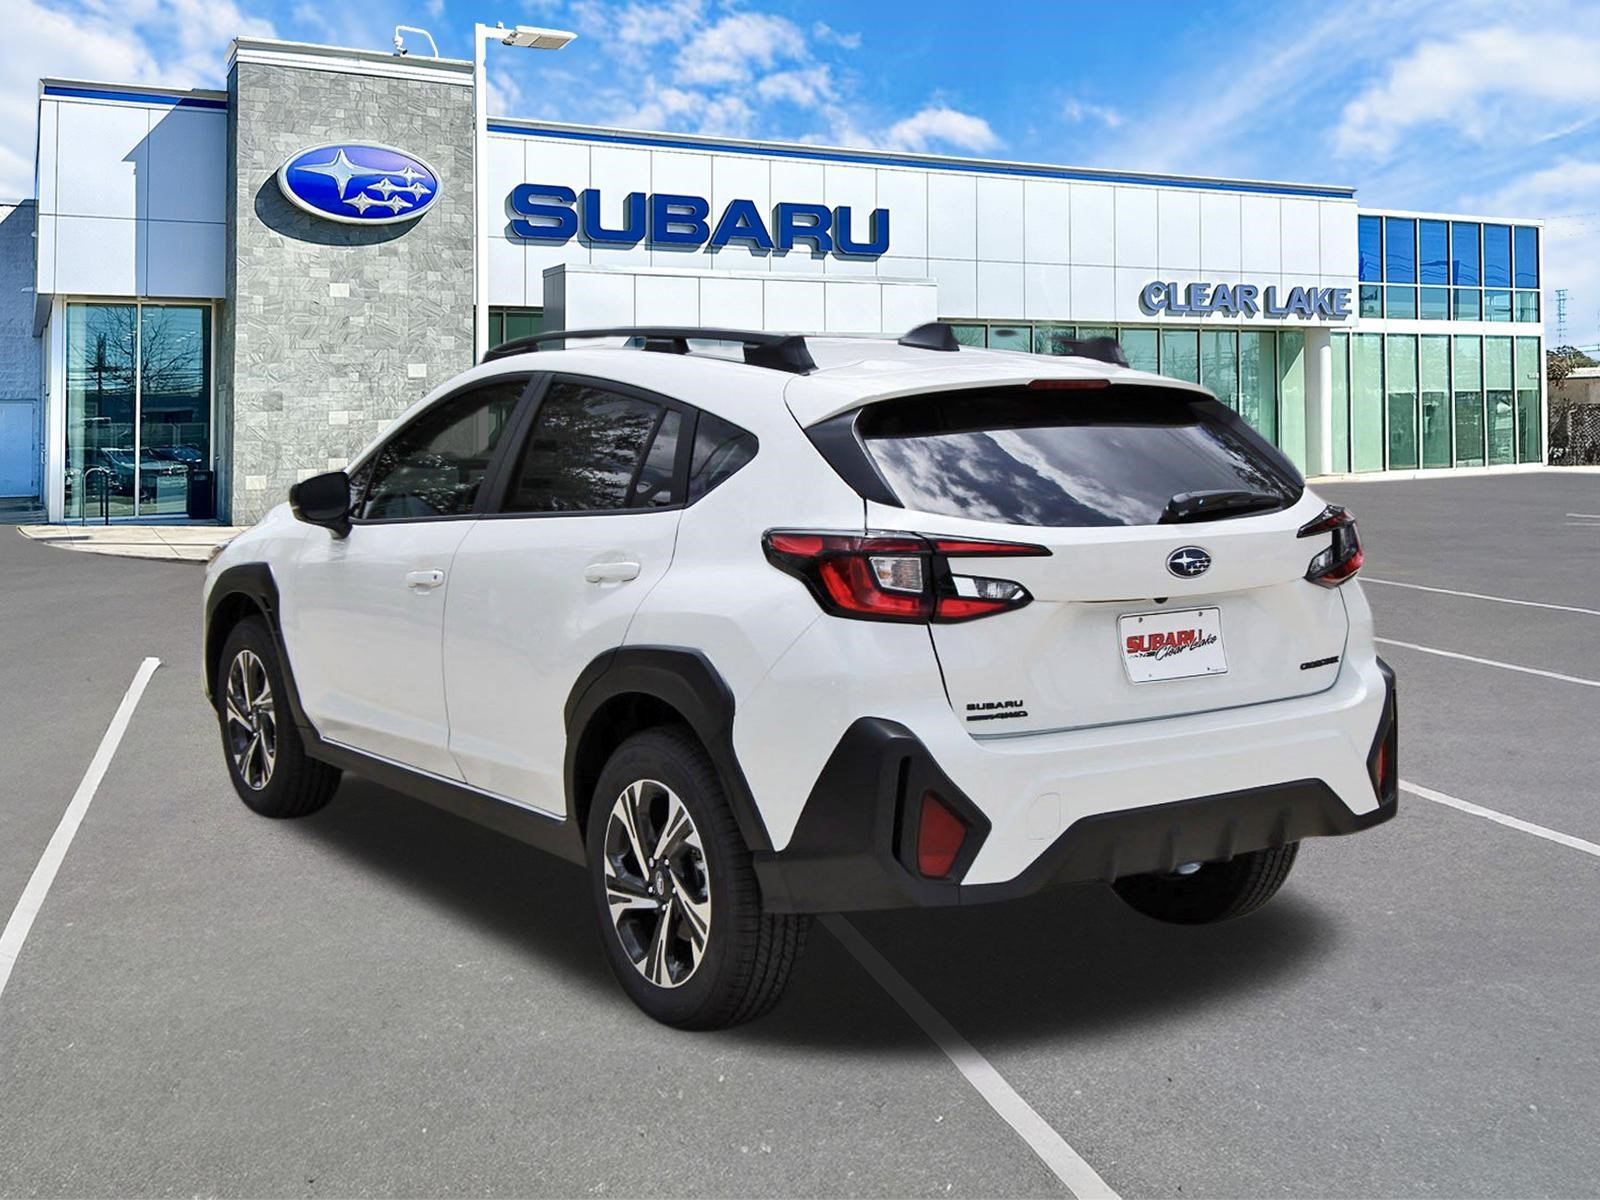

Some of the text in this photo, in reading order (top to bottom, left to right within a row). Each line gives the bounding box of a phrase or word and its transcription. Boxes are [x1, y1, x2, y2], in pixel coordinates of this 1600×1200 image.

[505, 182, 890, 261] SUBARU
[1140, 281, 1352, 319] CLEAR LAKE
[1127, 628, 1202, 653] SUBARU
[1155, 644, 1191, 661] Clear
[966, 699, 1024, 711] SUBARU
